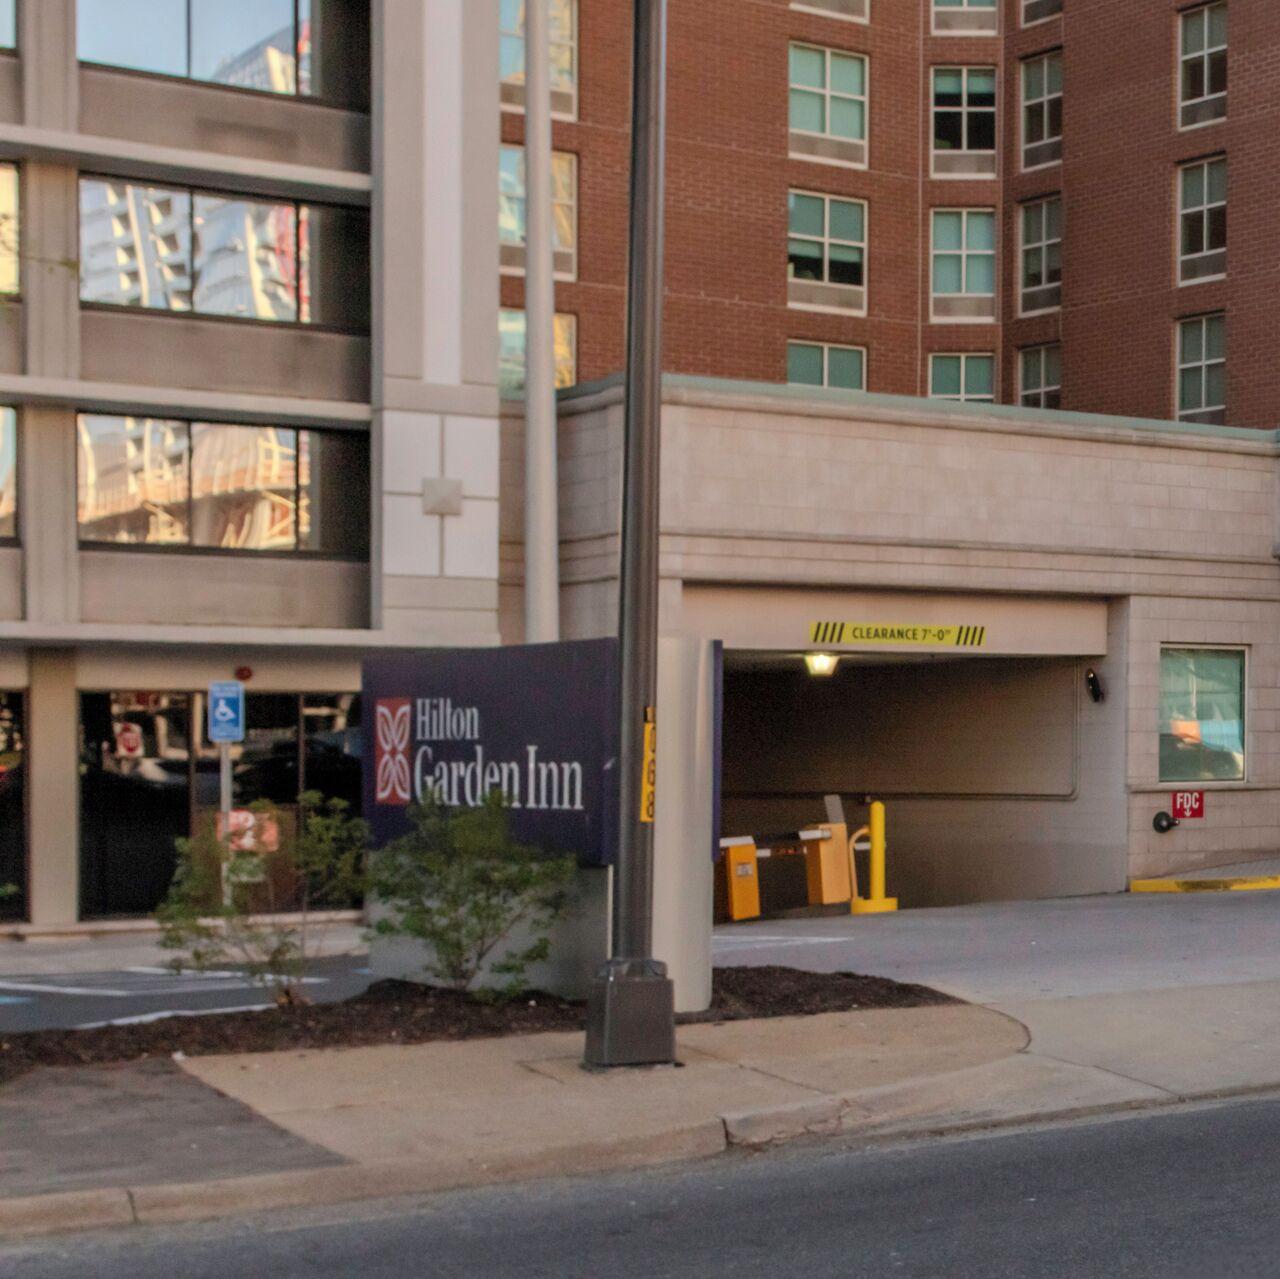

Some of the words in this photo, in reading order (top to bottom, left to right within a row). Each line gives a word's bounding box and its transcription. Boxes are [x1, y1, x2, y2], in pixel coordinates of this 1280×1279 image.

[852, 627, 918, 641] CLEARANCE
[416, 697, 479, 740] Hilton
[414, 744, 521, 807] Garden
[526, 745, 584, 810] Inn
[1176, 792, 1200, 809] FDC
